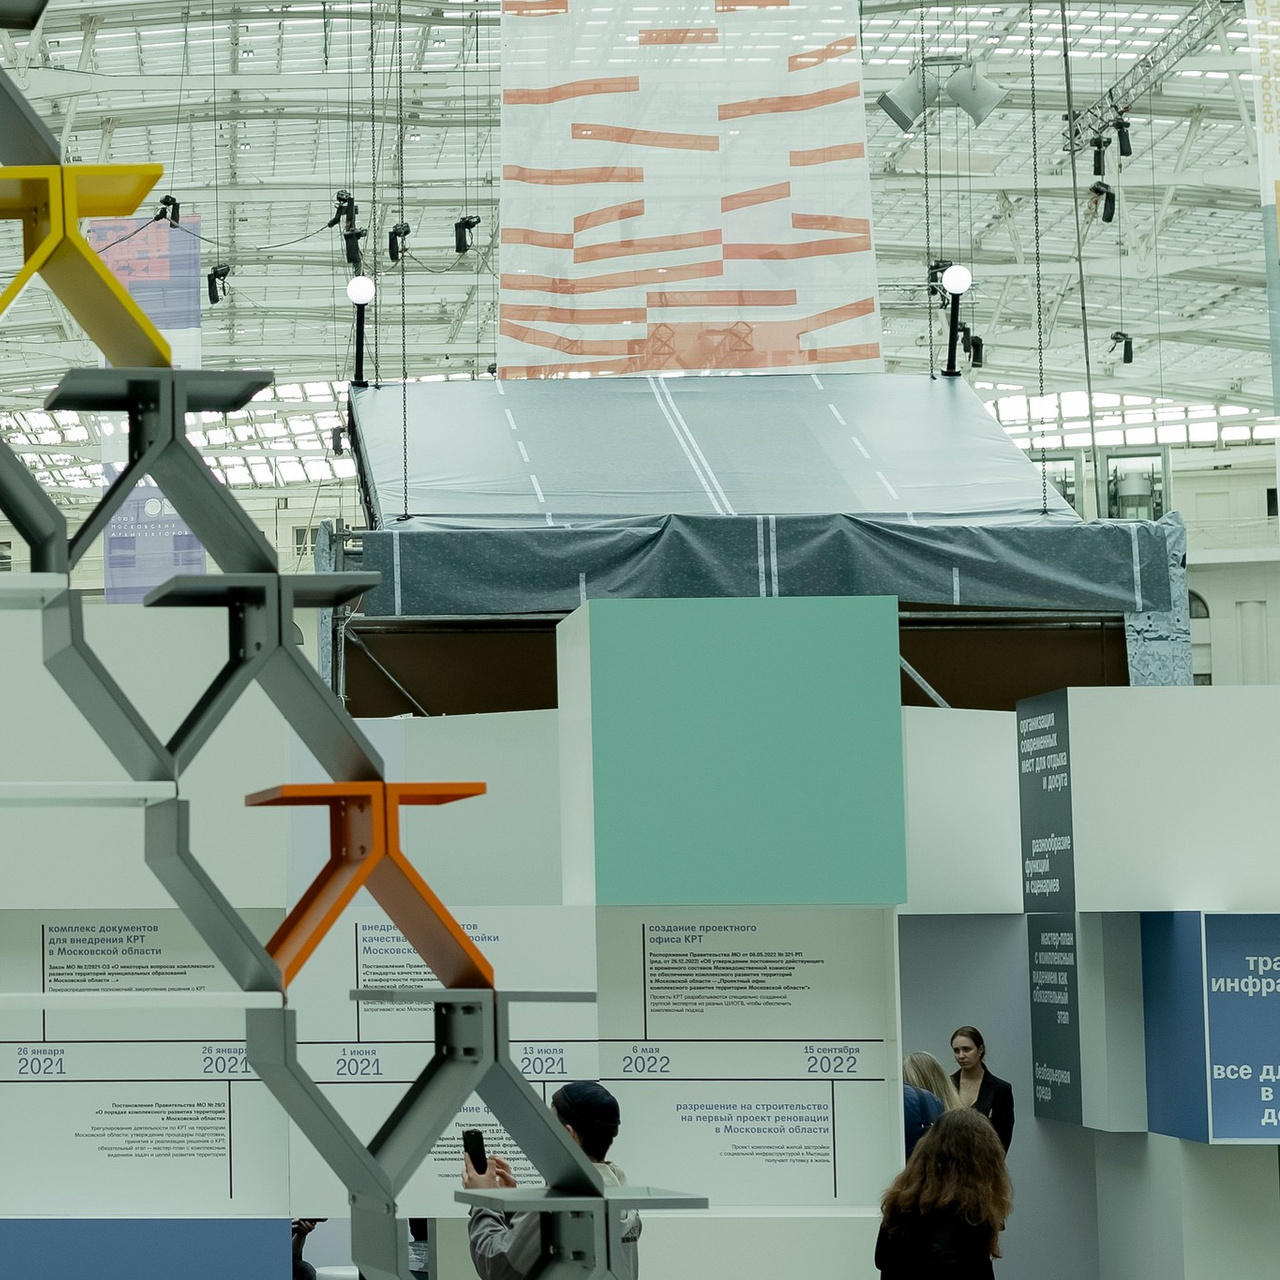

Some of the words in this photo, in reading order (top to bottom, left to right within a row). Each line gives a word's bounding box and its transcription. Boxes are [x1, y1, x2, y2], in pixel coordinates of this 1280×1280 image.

[1020, 712, 1055, 736] организация
[1020, 733, 1058, 755] современных
[1021, 758, 1035, 773] мест
[1035, 756, 1046, 773] для
[1047, 751, 1067, 769] отдыха
[1047, 772, 1068, 792] досуга
[1032, 832, 1071, 857] разнообразие
[1024, 854, 1050, 877] функций
[1030, 878, 1060, 897] сценариев
[98, 925, 159, 935] документов
[648, 925, 697, 935] создание
[699, 925, 757, 935] проектного
[48, 938, 67, 947] для
[70, 937, 124, 947] внедрения
[126, 934, 145, 944] КРТ
[649, 935, 682, 945] офиса
[684, 934, 704, 944] КРТ
[1040, 932, 1074, 950] мастер-план
[57, 946, 119, 956] Московской
[121, 946, 162, 956] области
[1039, 952, 1075, 965] комплексным
[1033, 970, 1058, 985] видением
[1058, 971, 1068, 985] как
[1033, 985, 1069, 1005] обязательный
[1057, 1011, 1070, 1025] этап
[17, 1046, 28, 1056] 26
[31, 1048, 65, 1058] января
[202, 1044, 213, 1054] 26
[342, 1047, 347, 1057] 1
[350, 1049, 377, 1057] июня
[523, 1045, 534, 1055] 13
[632, 1044, 638, 1054] 6
[804, 1044, 814, 1054] 15
[816, 1044, 860, 1057] сентября
[18, 1058, 66, 1074] 2021
[203, 1056, 252, 1073] 2021
[336, 1058, 382, 1075] 2021
[521, 1057, 567, 1075] 2021
[622, 1056, 670, 1073] 2022
[808, 1056, 857, 1073] 2022
[1213, 1064, 1253, 1080] все
[1035, 1062, 1071, 1086] безбарьерная
[1036, 1085, 1052, 1102] среда
[1261, 1087, 1274, 1101] в
[676, 1103, 738, 1113] разрешение
[740, 1103, 752, 1111] на
[755, 1103, 829, 1113] строительство
[696, 1112, 733, 1124] первый
[736, 1115, 771, 1125] проект
[774, 1115, 829, 1125] реновации
[1260, 1108, 1280, 1126] д
[715, 1126, 721, 1134] в
[723, 1124, 786, 1134] Московской
[788, 1124, 829, 1134] области
